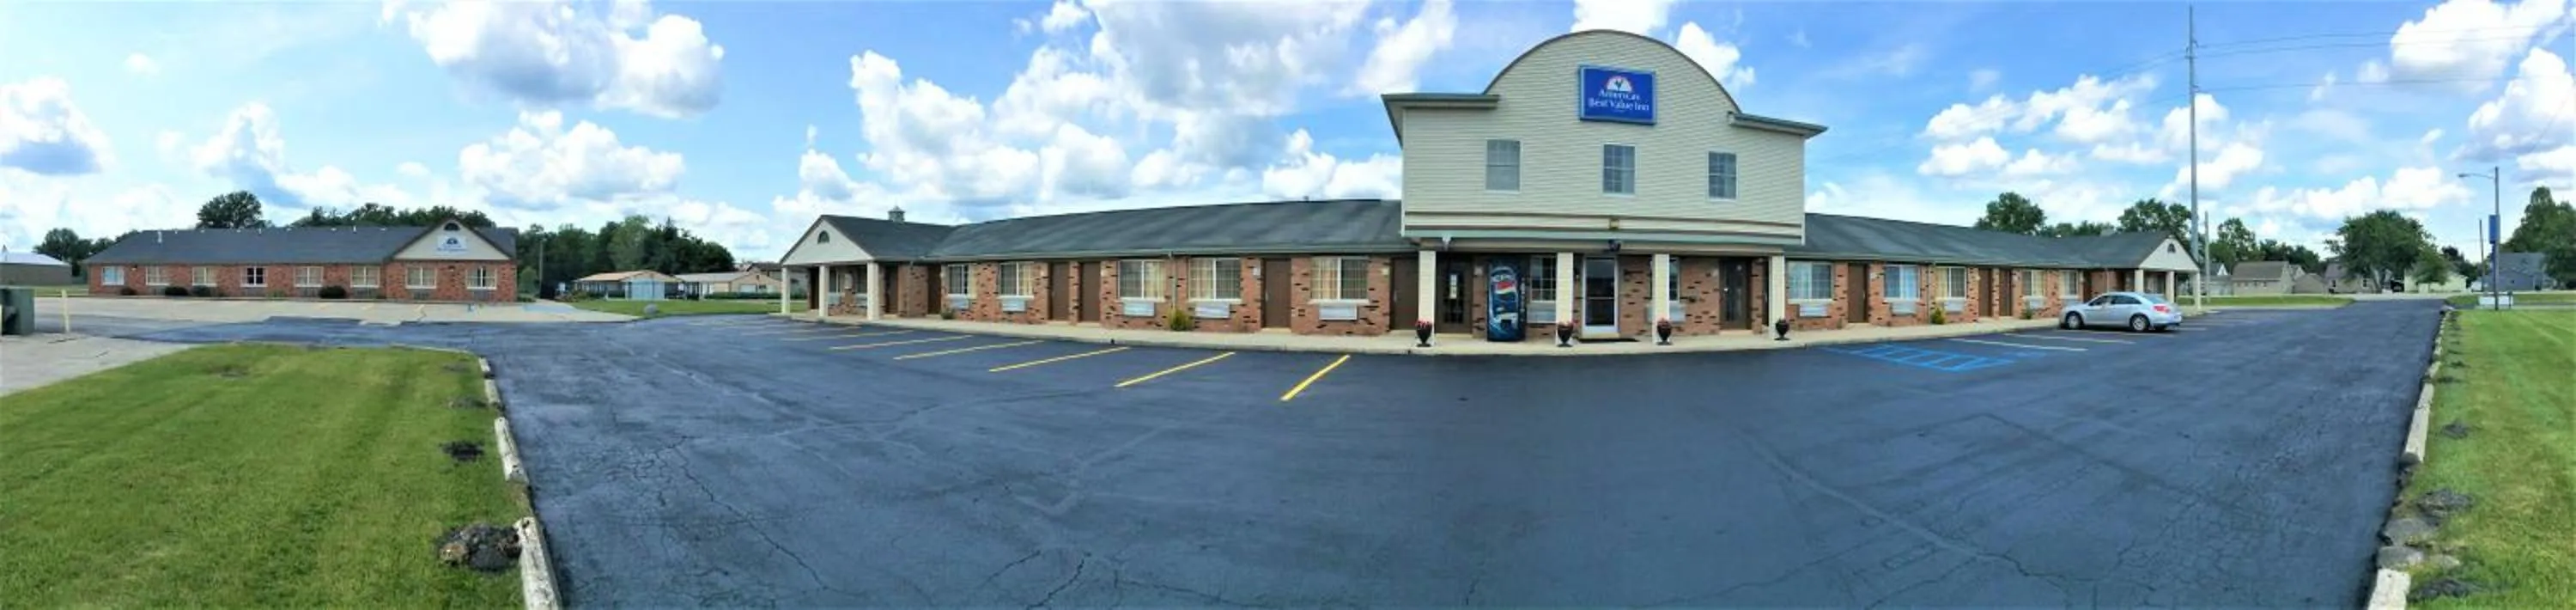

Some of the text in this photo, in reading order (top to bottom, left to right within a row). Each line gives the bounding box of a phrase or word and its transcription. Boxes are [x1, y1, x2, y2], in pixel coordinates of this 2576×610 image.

[1588, 97, 1649, 111] Best Value Inn
